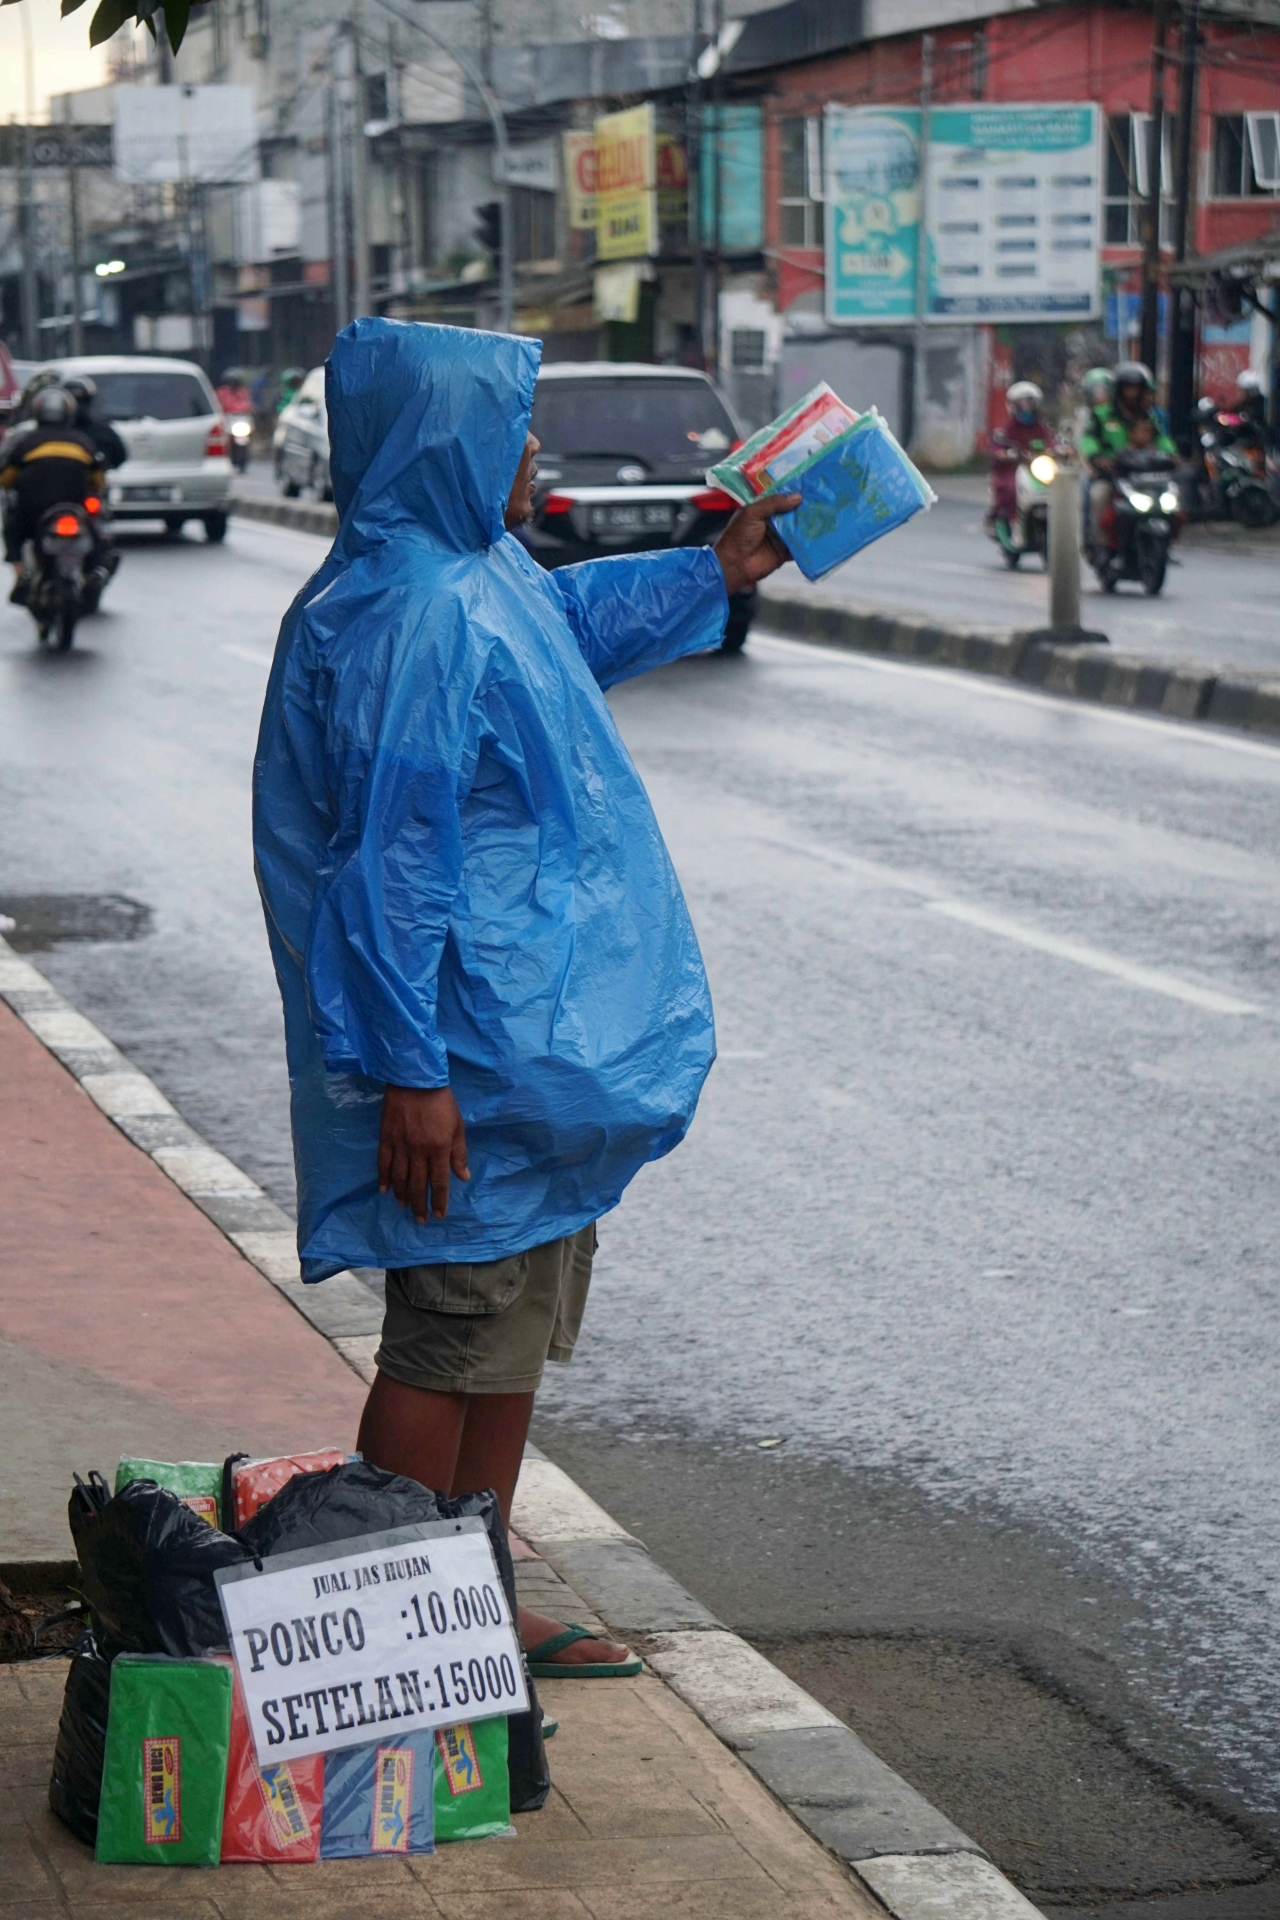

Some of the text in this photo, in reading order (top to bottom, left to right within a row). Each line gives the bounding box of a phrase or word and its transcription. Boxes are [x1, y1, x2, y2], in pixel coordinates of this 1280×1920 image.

[312, 1555, 432, 1598] JUAL JAS HUJAN
[243, 1583, 503, 1672] PONCO :10.000
[150, 1747, 165, 1805] DEWA RUCI
